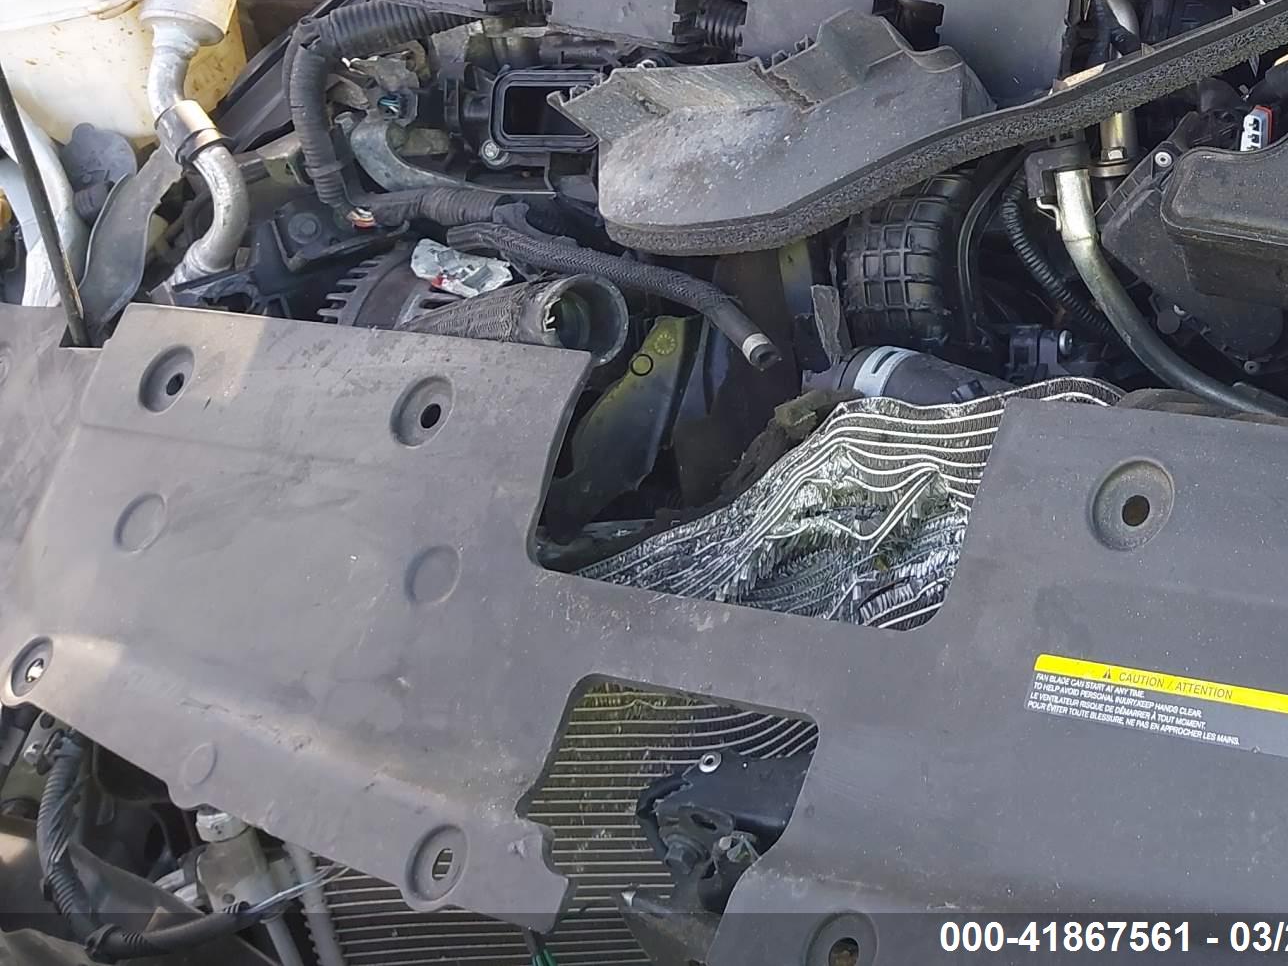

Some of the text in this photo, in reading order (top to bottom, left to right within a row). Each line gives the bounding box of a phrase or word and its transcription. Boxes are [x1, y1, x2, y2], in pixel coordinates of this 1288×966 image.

[1034, 681, 1042, 690] TO
[1043, 683, 1060, 692] HELP
[1060, 686, 1079, 696] AVOID
[1080, 689, 1114, 703] PERSONAL
[1154, 702, 1178, 714] HANDS
[1035, 673, 1049, 682] FAN
[1049, 675, 1070, 685] BLADE
[1071, 679, 1085, 688] CAN
[1085, 681, 1106, 691] START
[1105, 685, 1114, 693] AT
[1114, 686, 1129, 695] ANY
[1119, 672, 1165, 688] CAUTION
[1175, 681, 1233, 699] ATTENTION
[1028, 700, 1046, 711] POUR
[1046, 701, 1069, 714] ÉVITER
[1069, 707, 1090, 718] TOUTE
[1125, 718, 1136, 727] NE
[1136, 720, 1150, 729] PAS
[1150, 722, 1160, 731] EN
[1160, 724, 1202, 739] APPROCHER
[1202, 731, 1216, 741] LES
[1030, 691, 1039, 700] LE
[1039, 693, 1080, 707] VENTILATEUR
[1080, 700, 1104, 711] RISQUE
[1104, 704, 1115, 713] DE
[1115, 706, 1151, 721] DÉMARRER
[1157, 713, 1175, 724] TOUT
